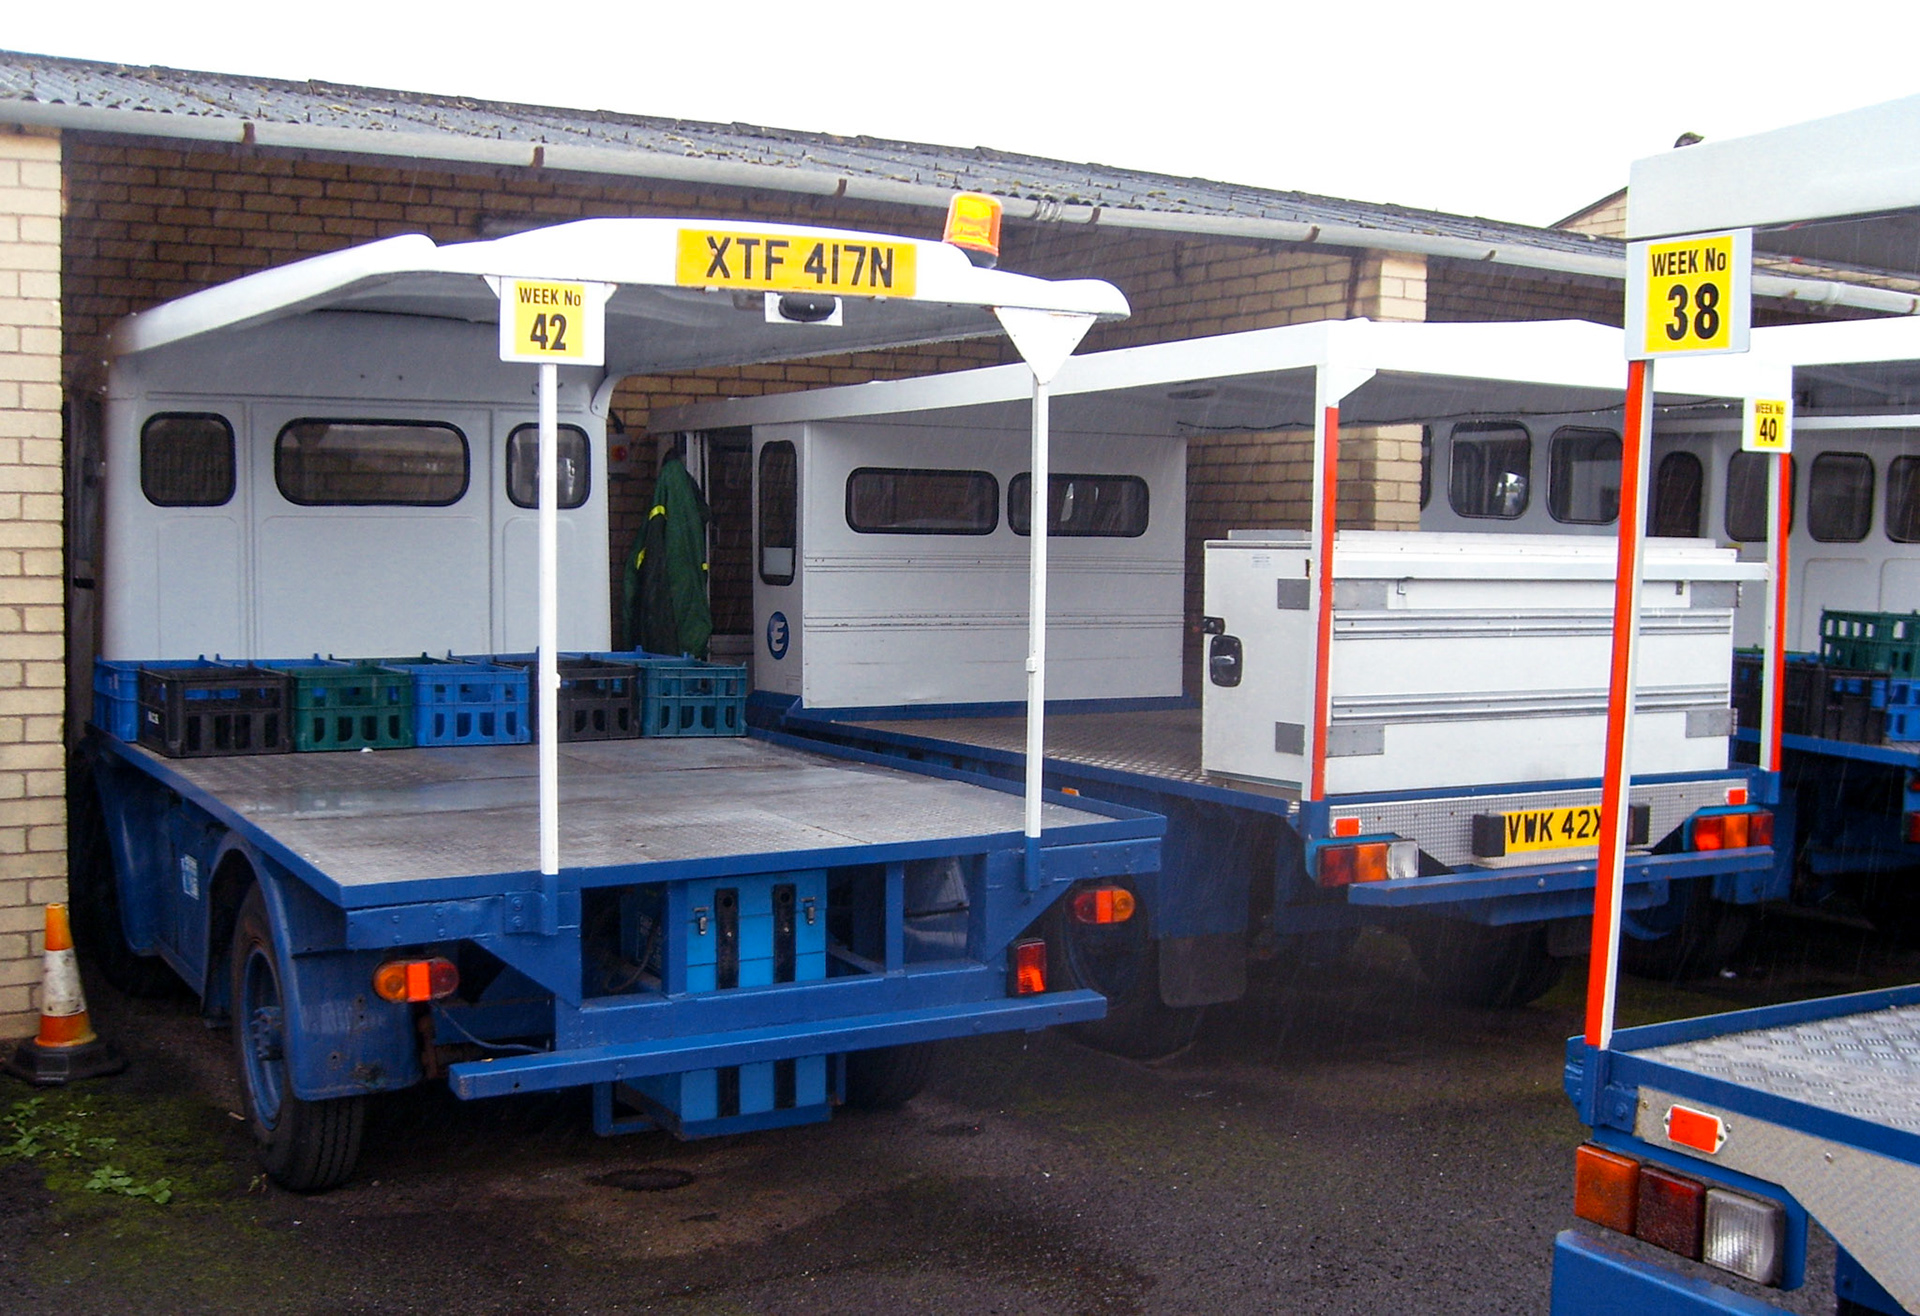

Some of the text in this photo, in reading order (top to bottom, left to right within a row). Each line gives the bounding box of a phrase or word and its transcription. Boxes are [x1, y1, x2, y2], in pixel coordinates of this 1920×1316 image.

[706, 236, 893, 288] XTF 417N
[1652, 248, 1727, 277] WEEK No
[519, 287, 581, 306] WEEK No
[1666, 283, 1720, 341] 38
[530, 313, 567, 351] 42
[1760, 417, 1777, 442] 40
[1508, 812, 1554, 844] VWK
